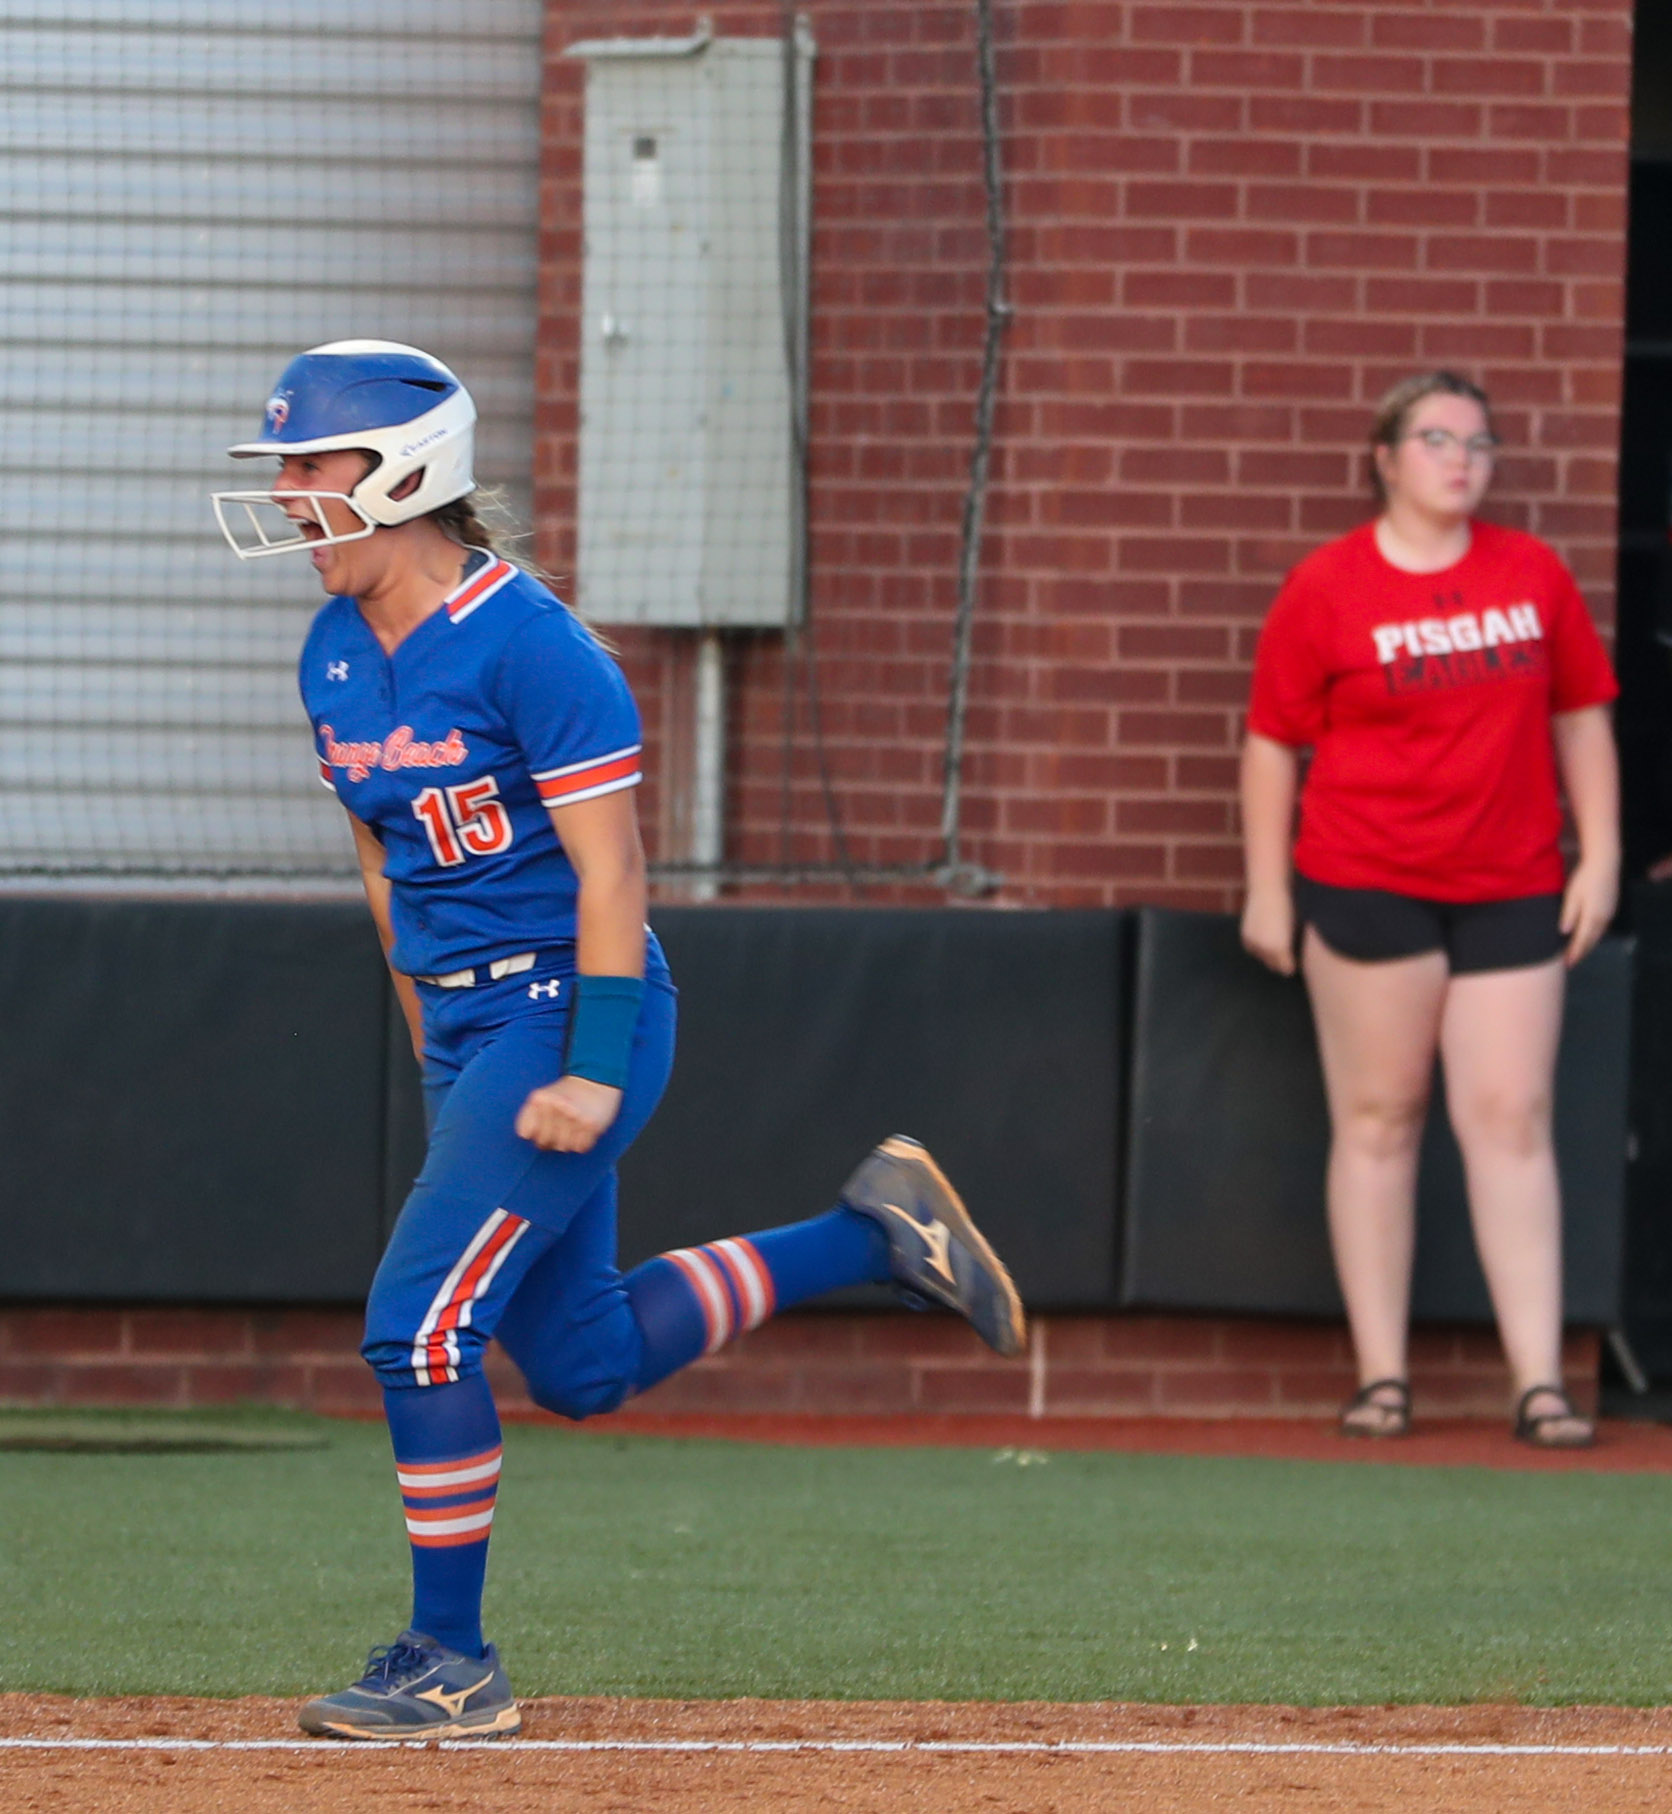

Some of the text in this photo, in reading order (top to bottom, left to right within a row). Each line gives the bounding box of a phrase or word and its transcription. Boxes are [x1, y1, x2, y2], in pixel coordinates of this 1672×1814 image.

[1373, 602, 1544, 664] PISGAH
[381, 724, 469, 772] Beach
[412, 774, 513, 867] 15
